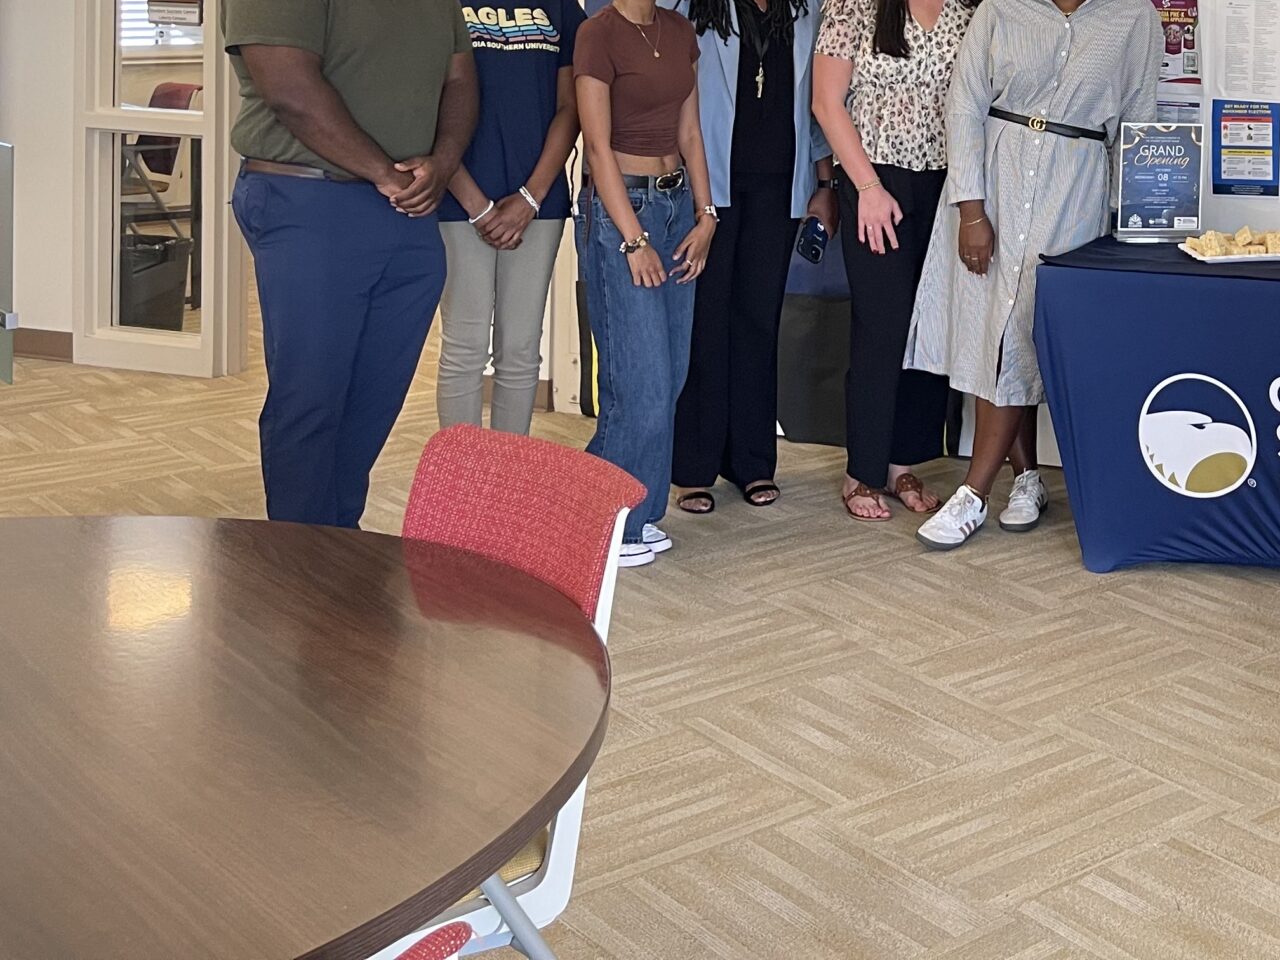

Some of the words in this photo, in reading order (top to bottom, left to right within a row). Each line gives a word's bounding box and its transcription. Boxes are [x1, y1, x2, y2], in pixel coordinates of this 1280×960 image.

[462, 6, 551, 28] AGLES
[1139, 145, 1185, 156] GRAND
[1134, 153, 1190, 168] Opening
[1157, 173, 1169, 181] 08
